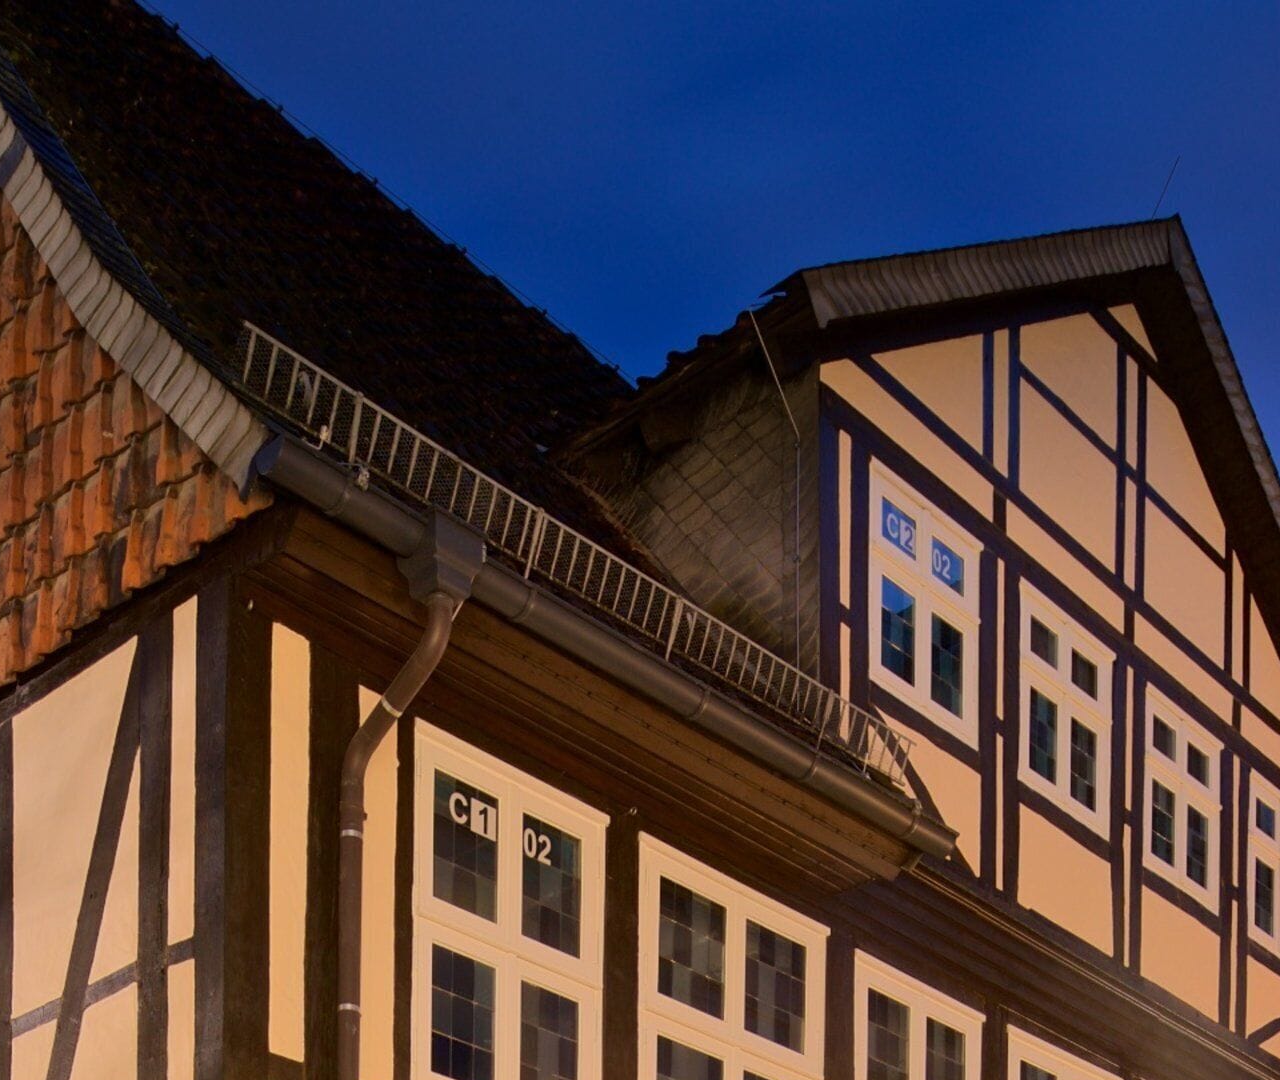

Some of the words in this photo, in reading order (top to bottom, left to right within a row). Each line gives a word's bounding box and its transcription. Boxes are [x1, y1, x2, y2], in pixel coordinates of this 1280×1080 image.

[933, 548, 951, 580] 02
[449, 791, 497, 842] C1
[523, 827, 552, 866] 02
